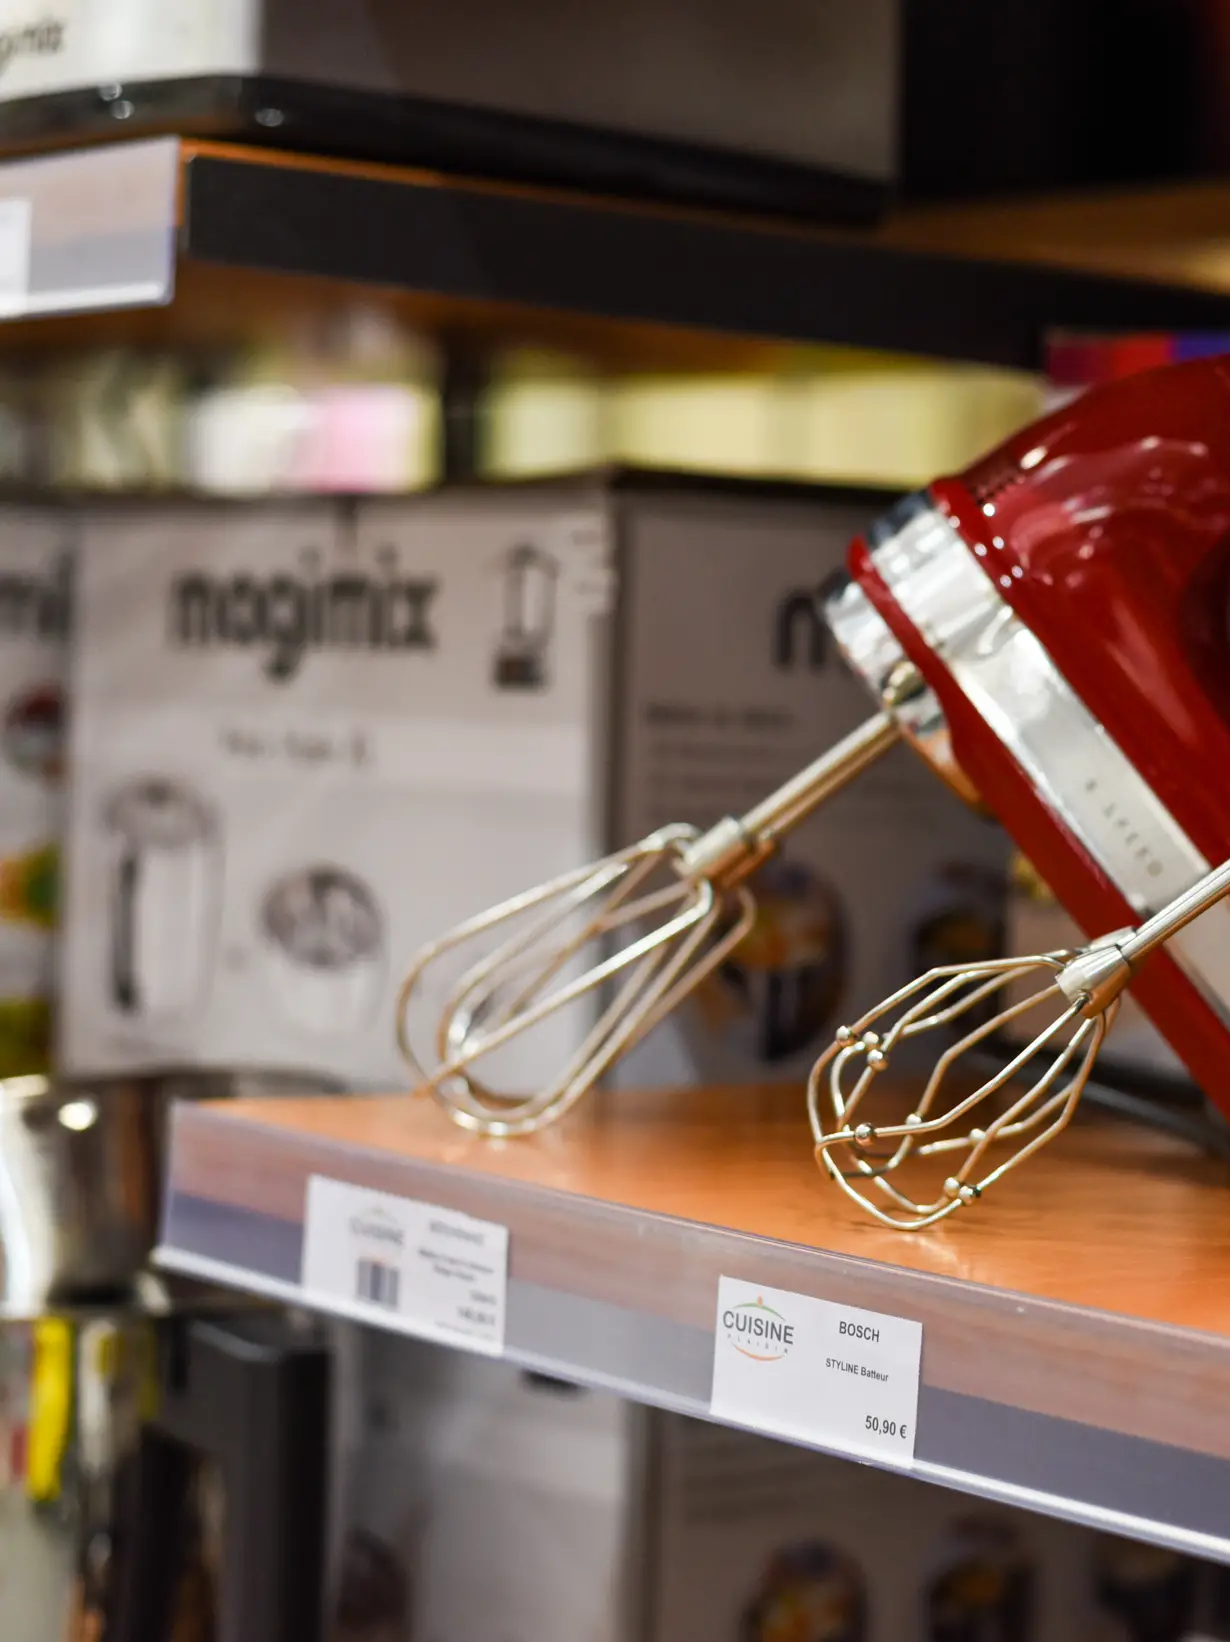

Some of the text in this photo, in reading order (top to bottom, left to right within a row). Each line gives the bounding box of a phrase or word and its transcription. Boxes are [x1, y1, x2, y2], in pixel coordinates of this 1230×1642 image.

[723, 1310, 795, 1345] CUISINE
[839, 1321, 881, 1343] BOSCH
[825, 1357, 889, 1382] STYLINE Batteur
[865, 1415, 908, 1439] 50,90 €
